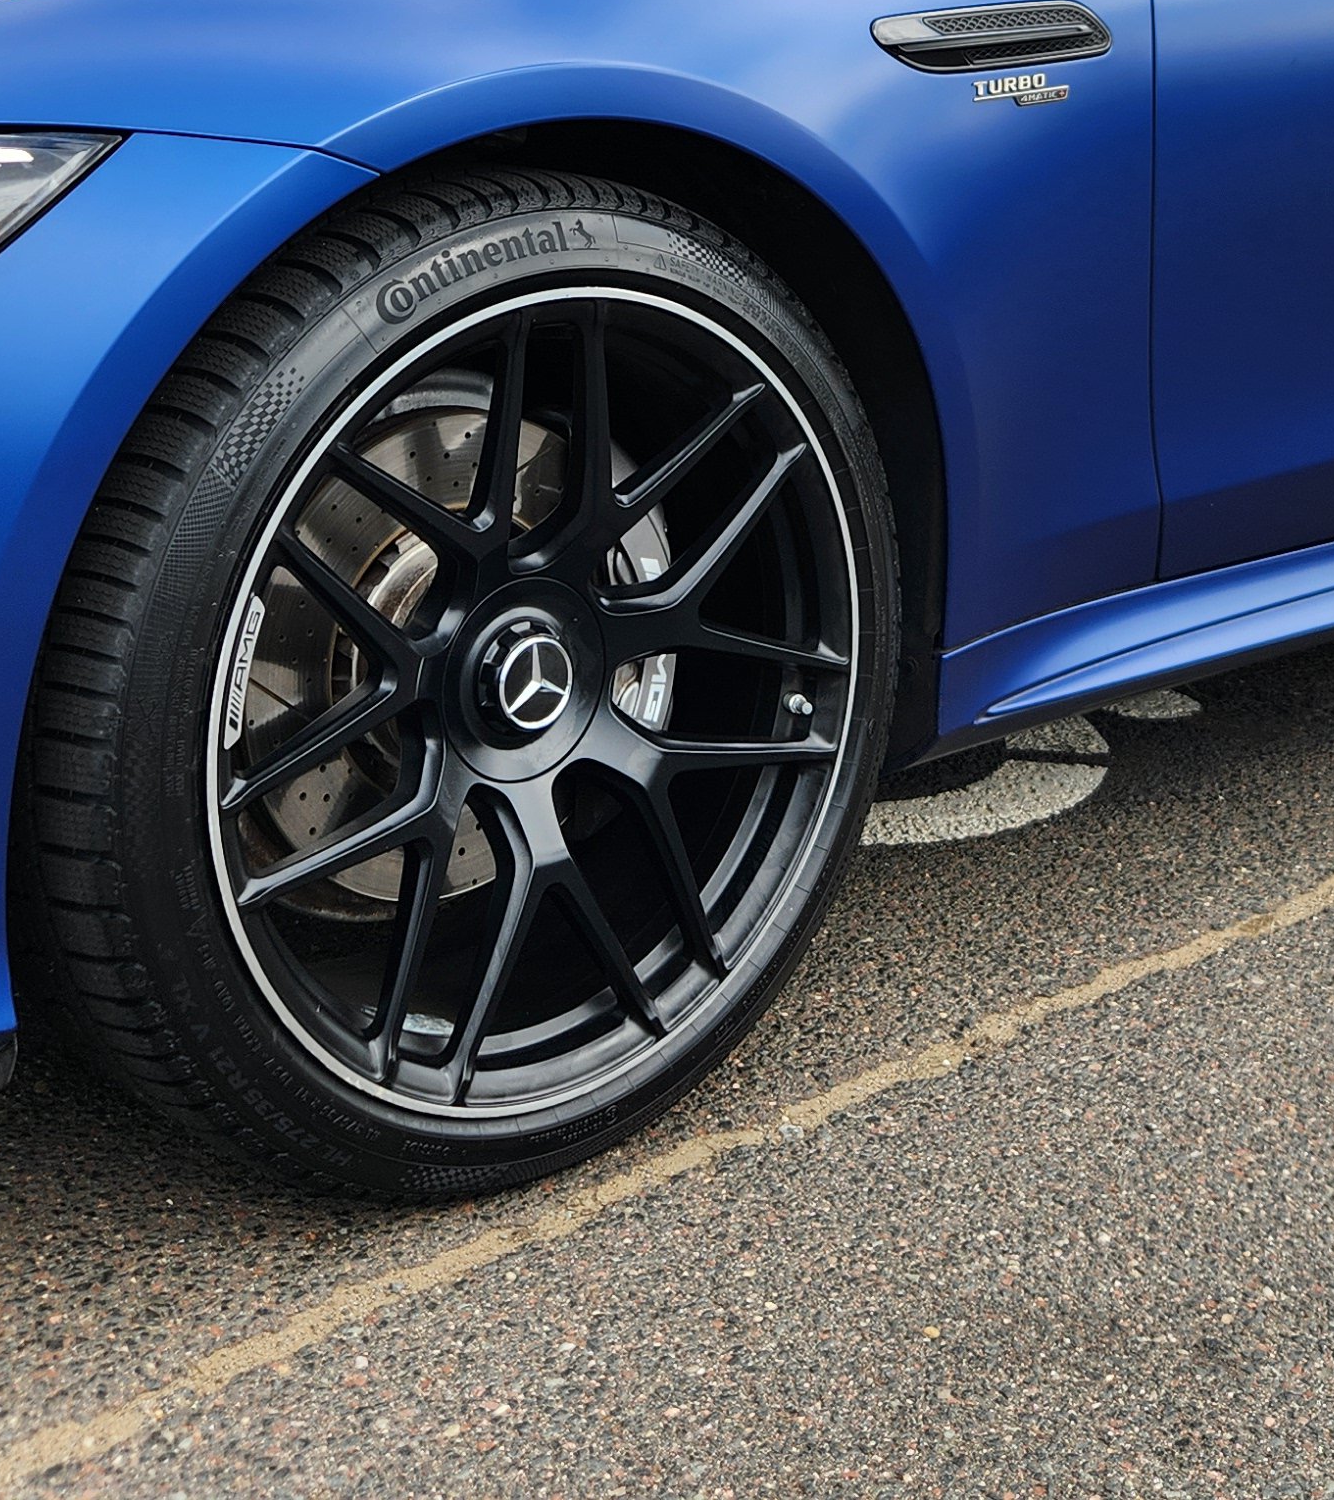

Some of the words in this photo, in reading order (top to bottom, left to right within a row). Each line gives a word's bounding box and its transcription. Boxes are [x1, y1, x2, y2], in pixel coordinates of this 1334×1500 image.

[973, 73, 1046, 97] TURBO
[375, 220, 569, 325] Continental
[234, 610, 261, 693] AMG
